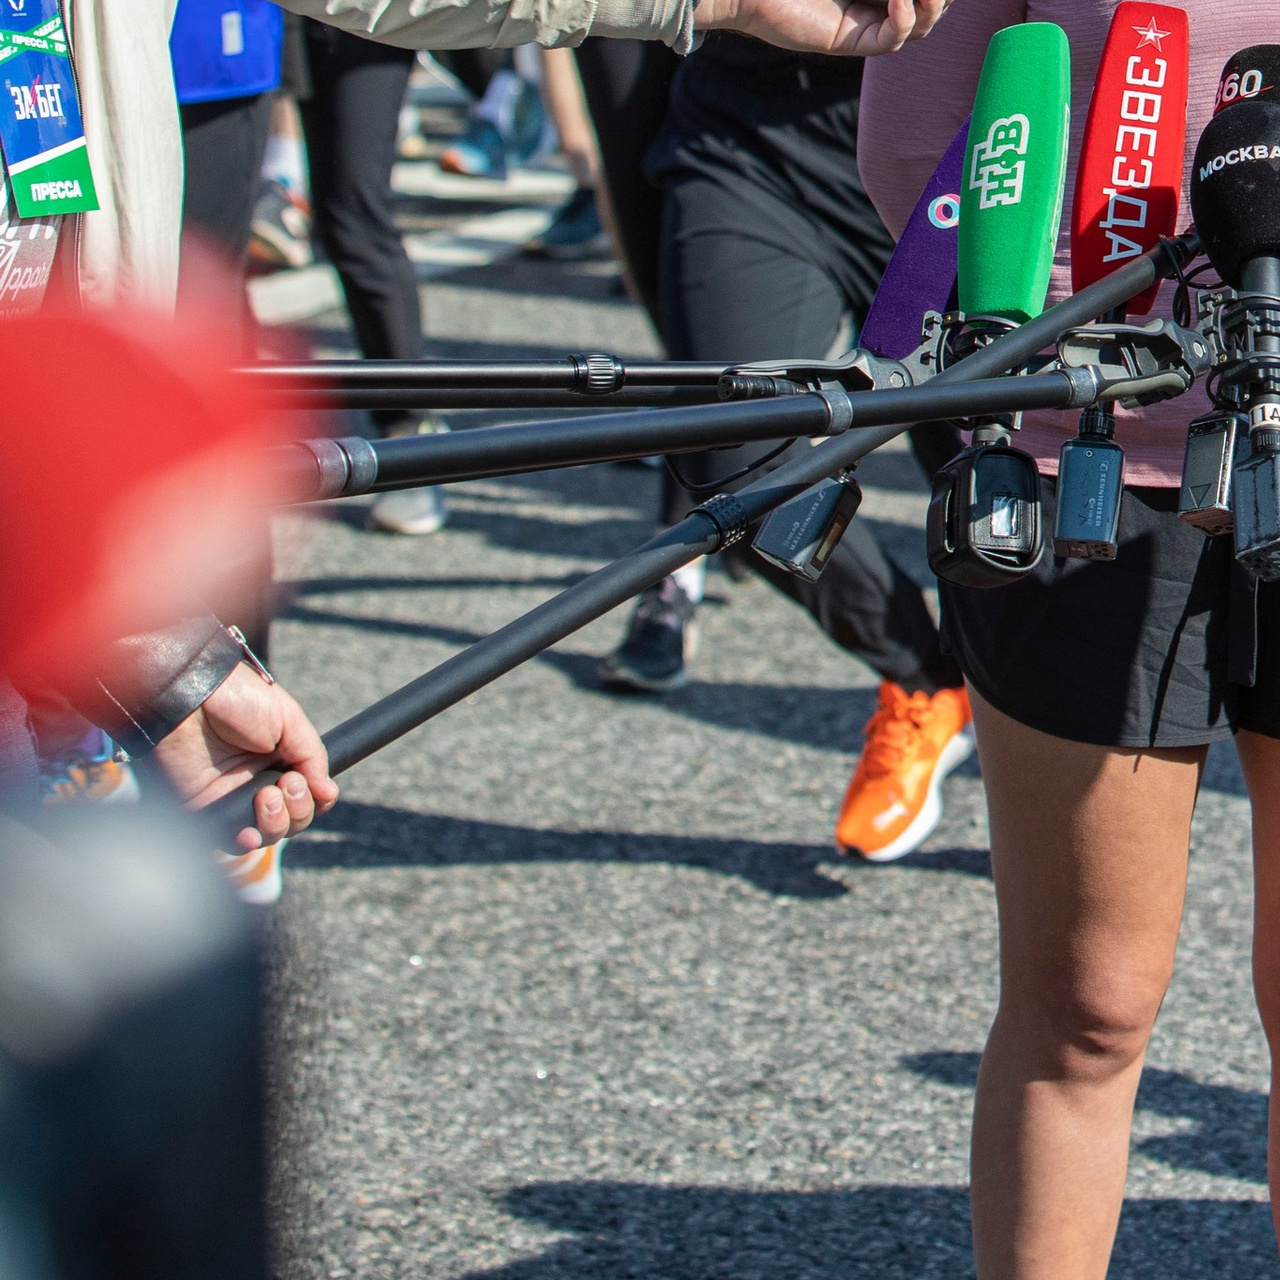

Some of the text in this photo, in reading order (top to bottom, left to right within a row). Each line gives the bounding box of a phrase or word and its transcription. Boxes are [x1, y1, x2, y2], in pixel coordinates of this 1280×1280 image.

[12, 34, 49, 50] ПРЕССА
[1099, 55, 1167, 263] ЗВЕЗДА
[30, 180, 83, 202] ПРЕССА
